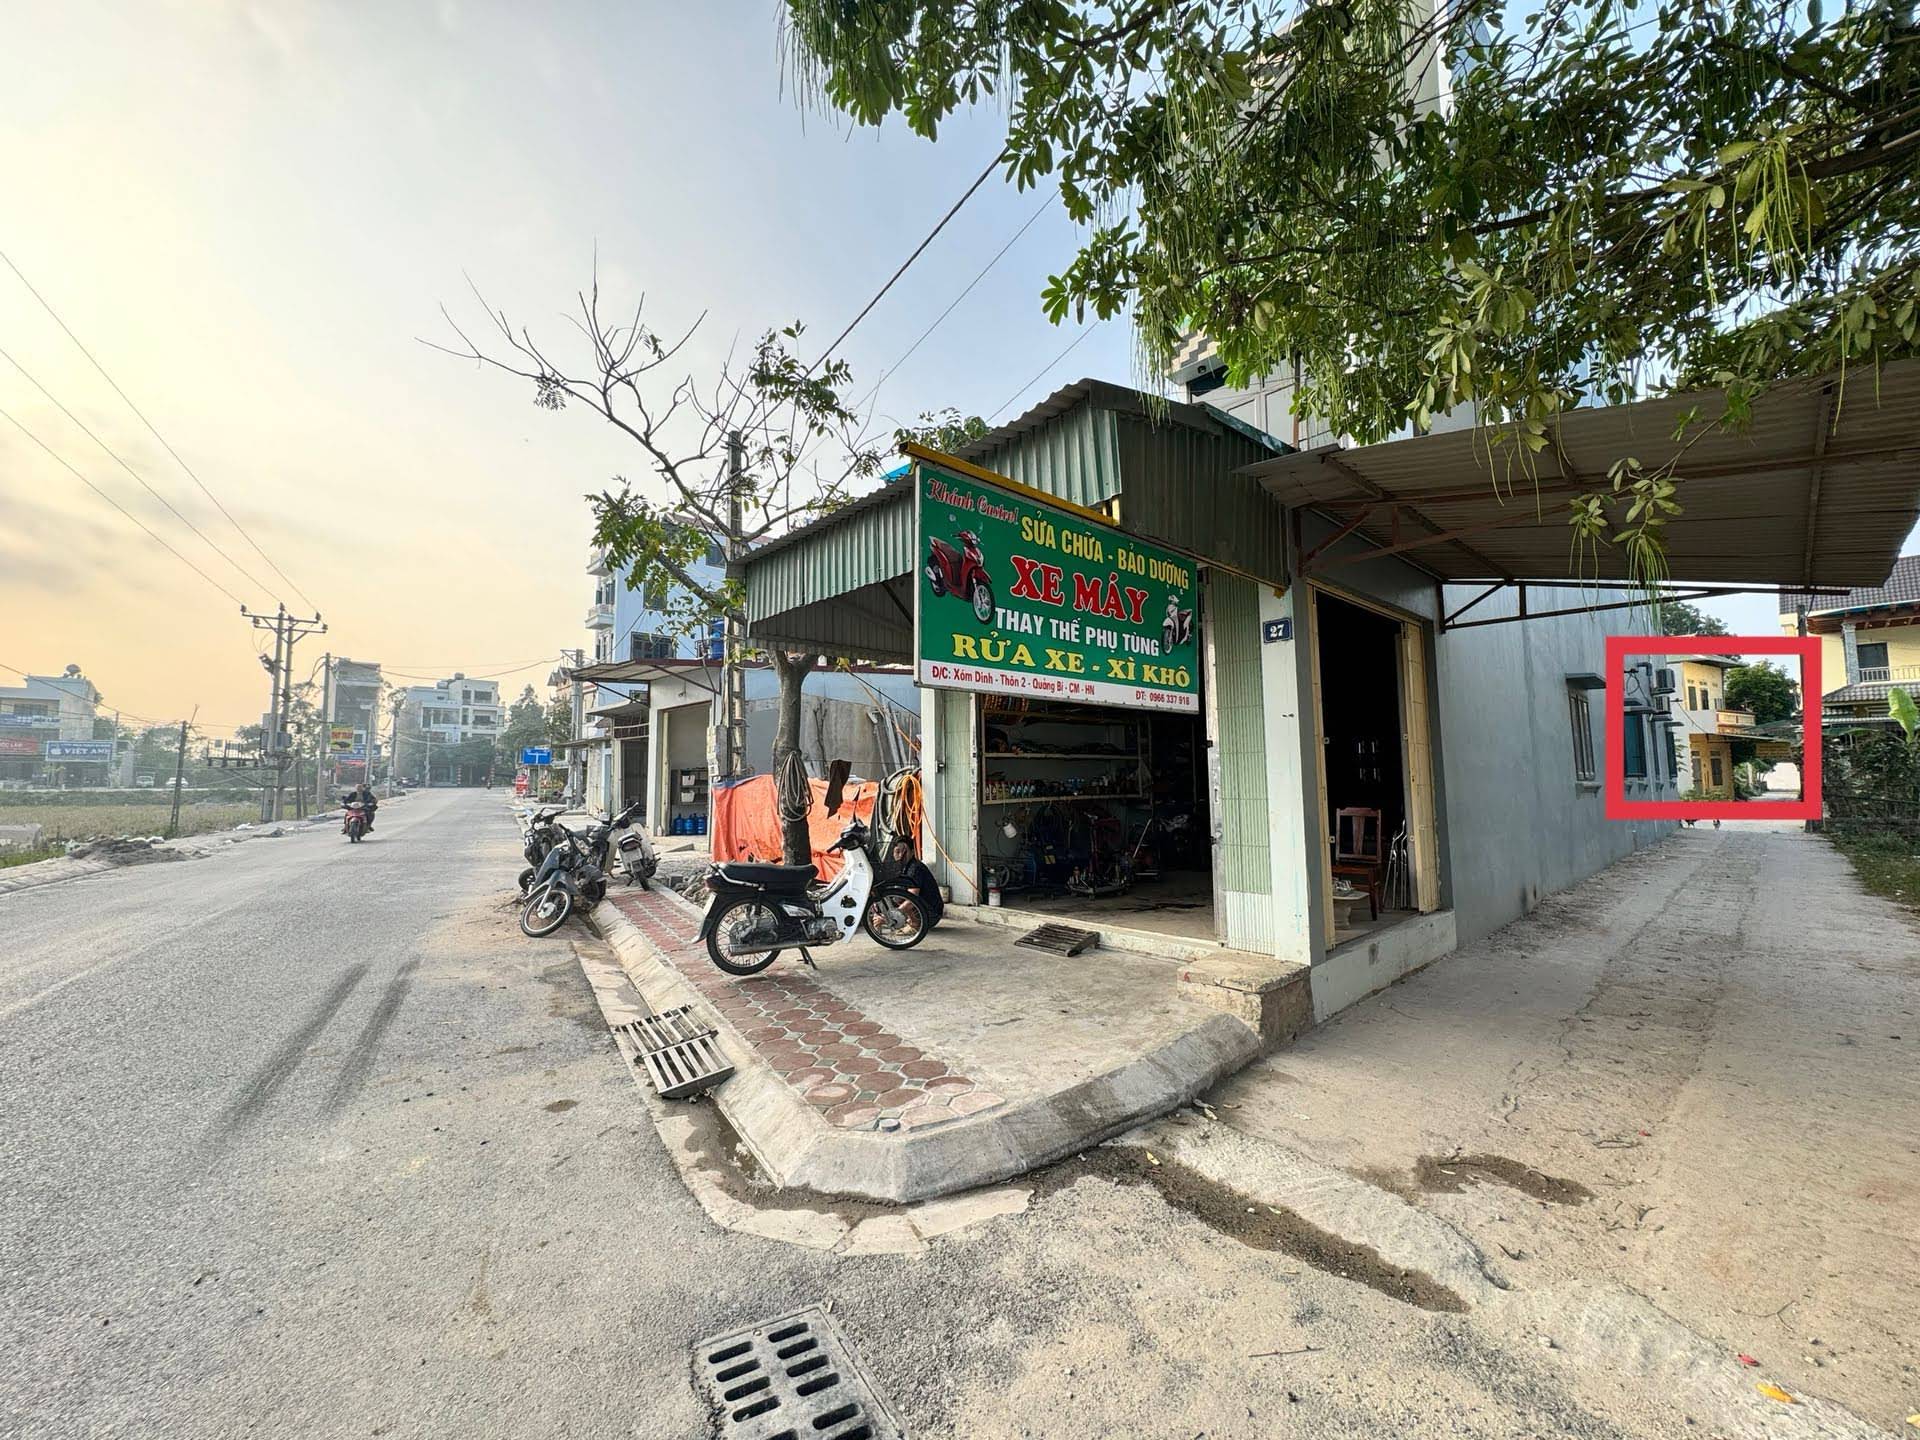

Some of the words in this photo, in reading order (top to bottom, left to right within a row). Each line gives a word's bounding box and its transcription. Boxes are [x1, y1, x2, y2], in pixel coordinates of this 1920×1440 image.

[1021, 510, 1056, 550] SỬA
[1061, 529, 1104, 564] CHỮA
[1118, 543, 1146, 576] BẢO
[1149, 558, 1189, 590] DƯỠNG
[1010, 555, 1065, 607] XE
[1073, 572, 1150, 624] MÁY
[995, 607, 1045, 636] THAY
[1049, 617, 1081, 643] THẾ
[1085, 627, 1118, 653] PHỤ
[1122, 631, 1160, 657] TÙNG
[1270, 623, 1285, 638] 27
[932, 665, 951, 680] Đ/C:
[953, 667, 973, 681] Xóm
[1000, 674, 1020, 687] Thôn
[1021, 677, 1026, 688] 2
[1069, 682, 1080, 694] CM
[1085, 684, 1095, 696] HN
[952, 630, 1036, 667] RỬA
[1045, 649, 1085, 674] XE
[1107, 657, 1136, 681] XÌ
[1142, 664, 1191, 688] KHÔ
